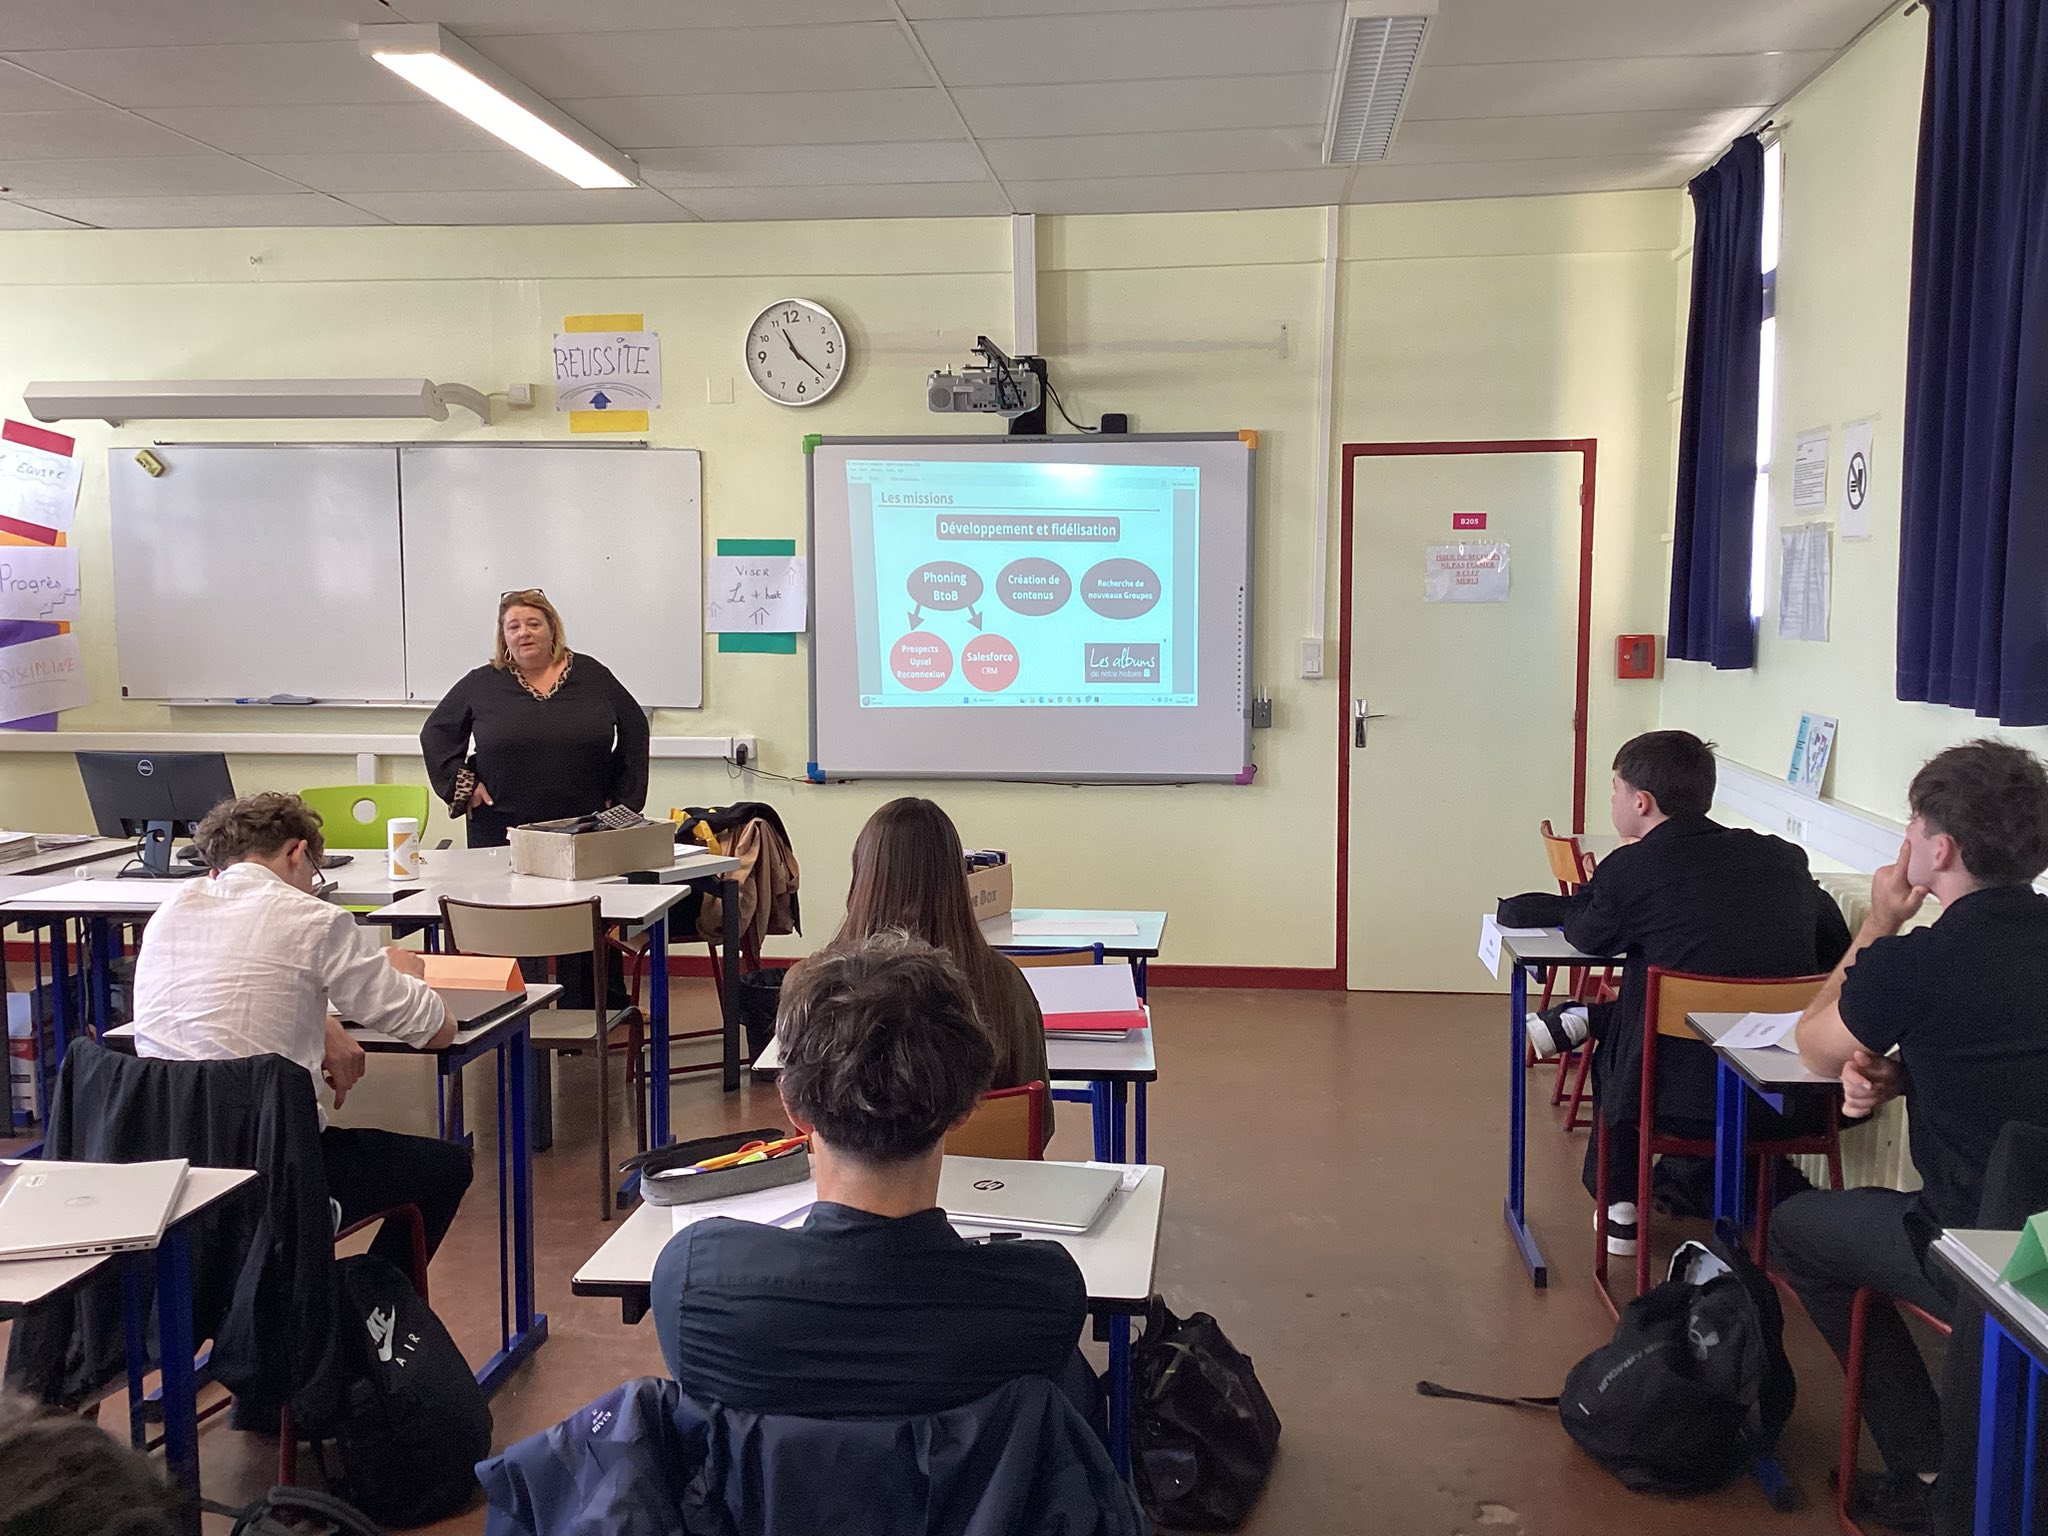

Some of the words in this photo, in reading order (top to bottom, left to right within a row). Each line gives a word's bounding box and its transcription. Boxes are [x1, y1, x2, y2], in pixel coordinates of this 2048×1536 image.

[782, 310, 800, 324] 12
[807, 315, 812, 323] 1
[771, 320, 780, 328] 11
[820, 326, 826, 334] 2
[760, 335, 770, 343] 10
[826, 341, 835, 354] 3
[757, 351, 767, 364] 9
[825, 362, 831, 370] 4
[767, 370, 773, 378] 8
[780, 381, 786, 389] 7
[815, 376, 821, 384] 5
[796, 381, 806, 394] 6
[881, 492, 900, 504] Les
[903, 491, 954, 505] missions
[940, 521, 1034, 538] Développement
[1036, 523, 1049, 536] et
[1051, 522, 1117, 537] fidélisation
[0, 563, 62, 593] Progrès
[923, 571, 967, 586] Phoning
[1008, 574, 1046, 585] Création
[1048, 575, 1060, 585] de
[1097, 579, 1134, 588] Recherche
[1134, 579, 1145, 588] de
[933, 590, 959, 601] BtoB
[1012, 591, 1054, 600] contenus
[1088, 592, 1123, 600] nouveaux
[1123, 591, 1153, 601] Groupes
[901, 645, 938, 655] Prospects
[966, 651, 1014, 662] Salesforce
[1090, 647, 1109, 668] Les
[1112, 646, 1155, 669] albums
[910, 657, 932, 668] Upsel
[896, 670, 946, 679] Reconnexion
[981, 667, 998, 675] CRM
[980, 889, 997, 905] Box
[395, 1332, 421, 1368] AIR
